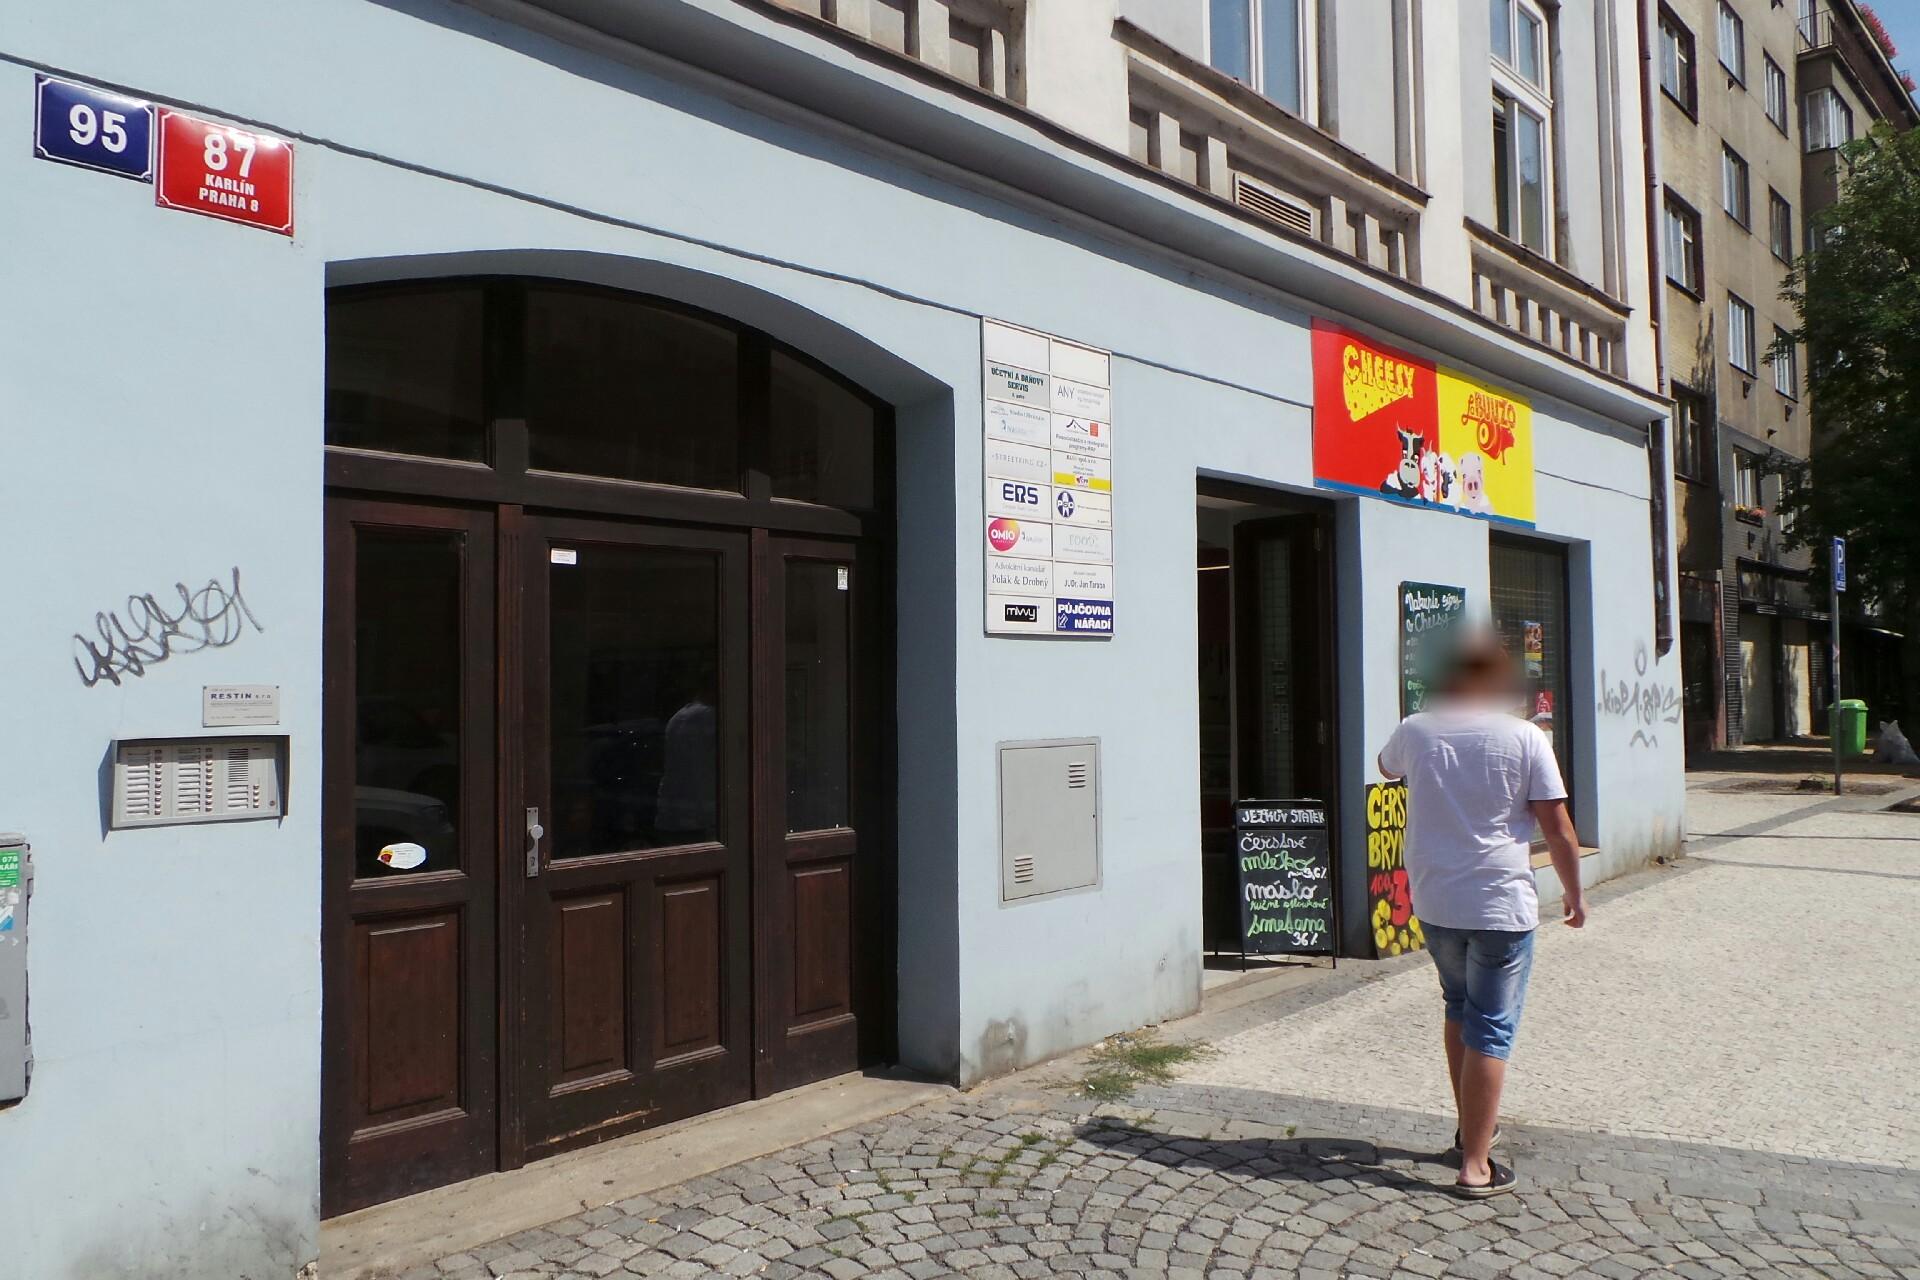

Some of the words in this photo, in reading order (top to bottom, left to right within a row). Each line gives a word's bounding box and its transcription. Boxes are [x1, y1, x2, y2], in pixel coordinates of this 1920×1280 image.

[68, 104, 128, 154] 95
[203, 133, 256, 178] 87
[205, 172, 255, 196] KARLÍN
[199, 186, 247, 210] PRAHA
[250, 199, 259, 213] 8
[1343, 345, 1415, 398] CHEESY
[1003, 482, 1039, 505] ERS
[991, 528, 1016, 541] OMIO
[1057, 602, 1112, 616] PŮJČOVNA
[1074, 617, 1111, 630] NÁŘADÍ
[210, 692, 252, 700] RESTIN
[1290, 809, 1325, 824] STATEK
[1245, 878, 1318, 902] máslo
[1247, 908, 1328, 938] smetana
[1291, 931, 1319, 946] 36%
